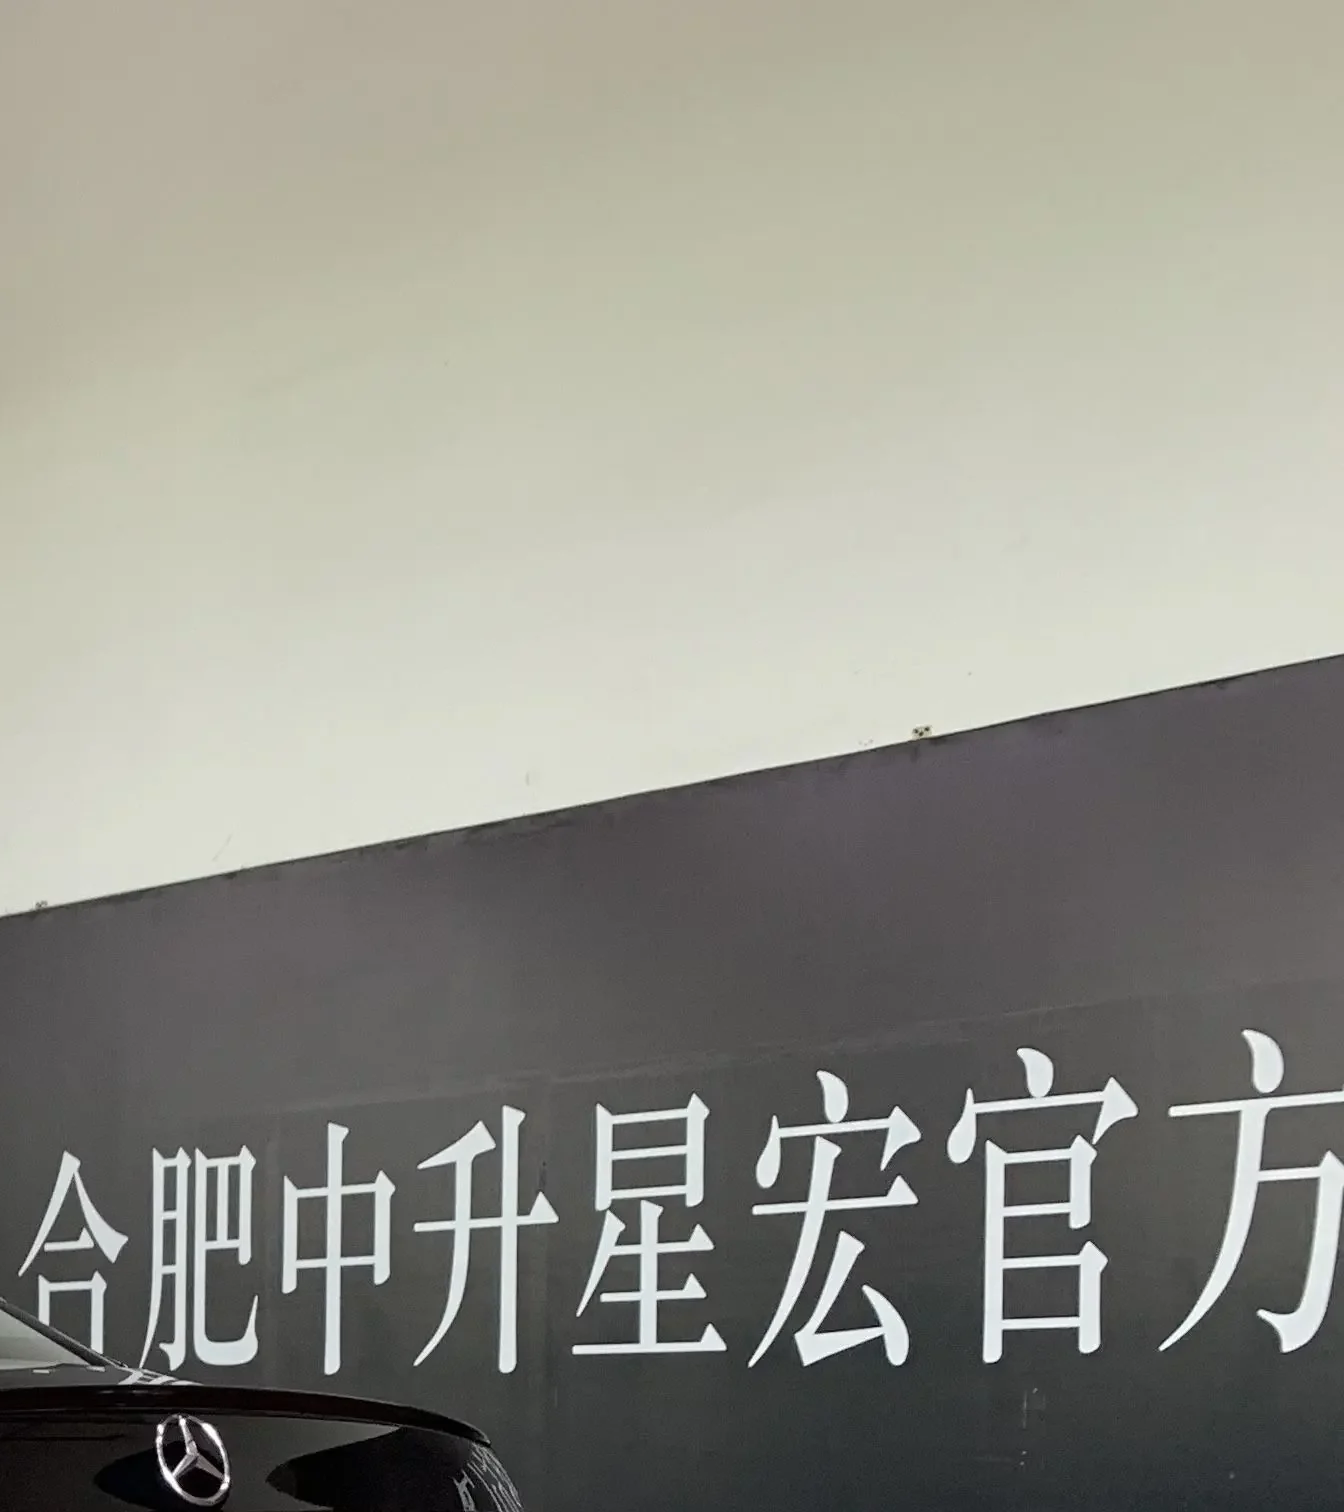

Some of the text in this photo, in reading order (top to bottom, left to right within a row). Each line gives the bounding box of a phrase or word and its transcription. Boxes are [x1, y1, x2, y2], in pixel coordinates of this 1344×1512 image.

[18, 1029, 1344, 1374] 合肥中升星宏官方
